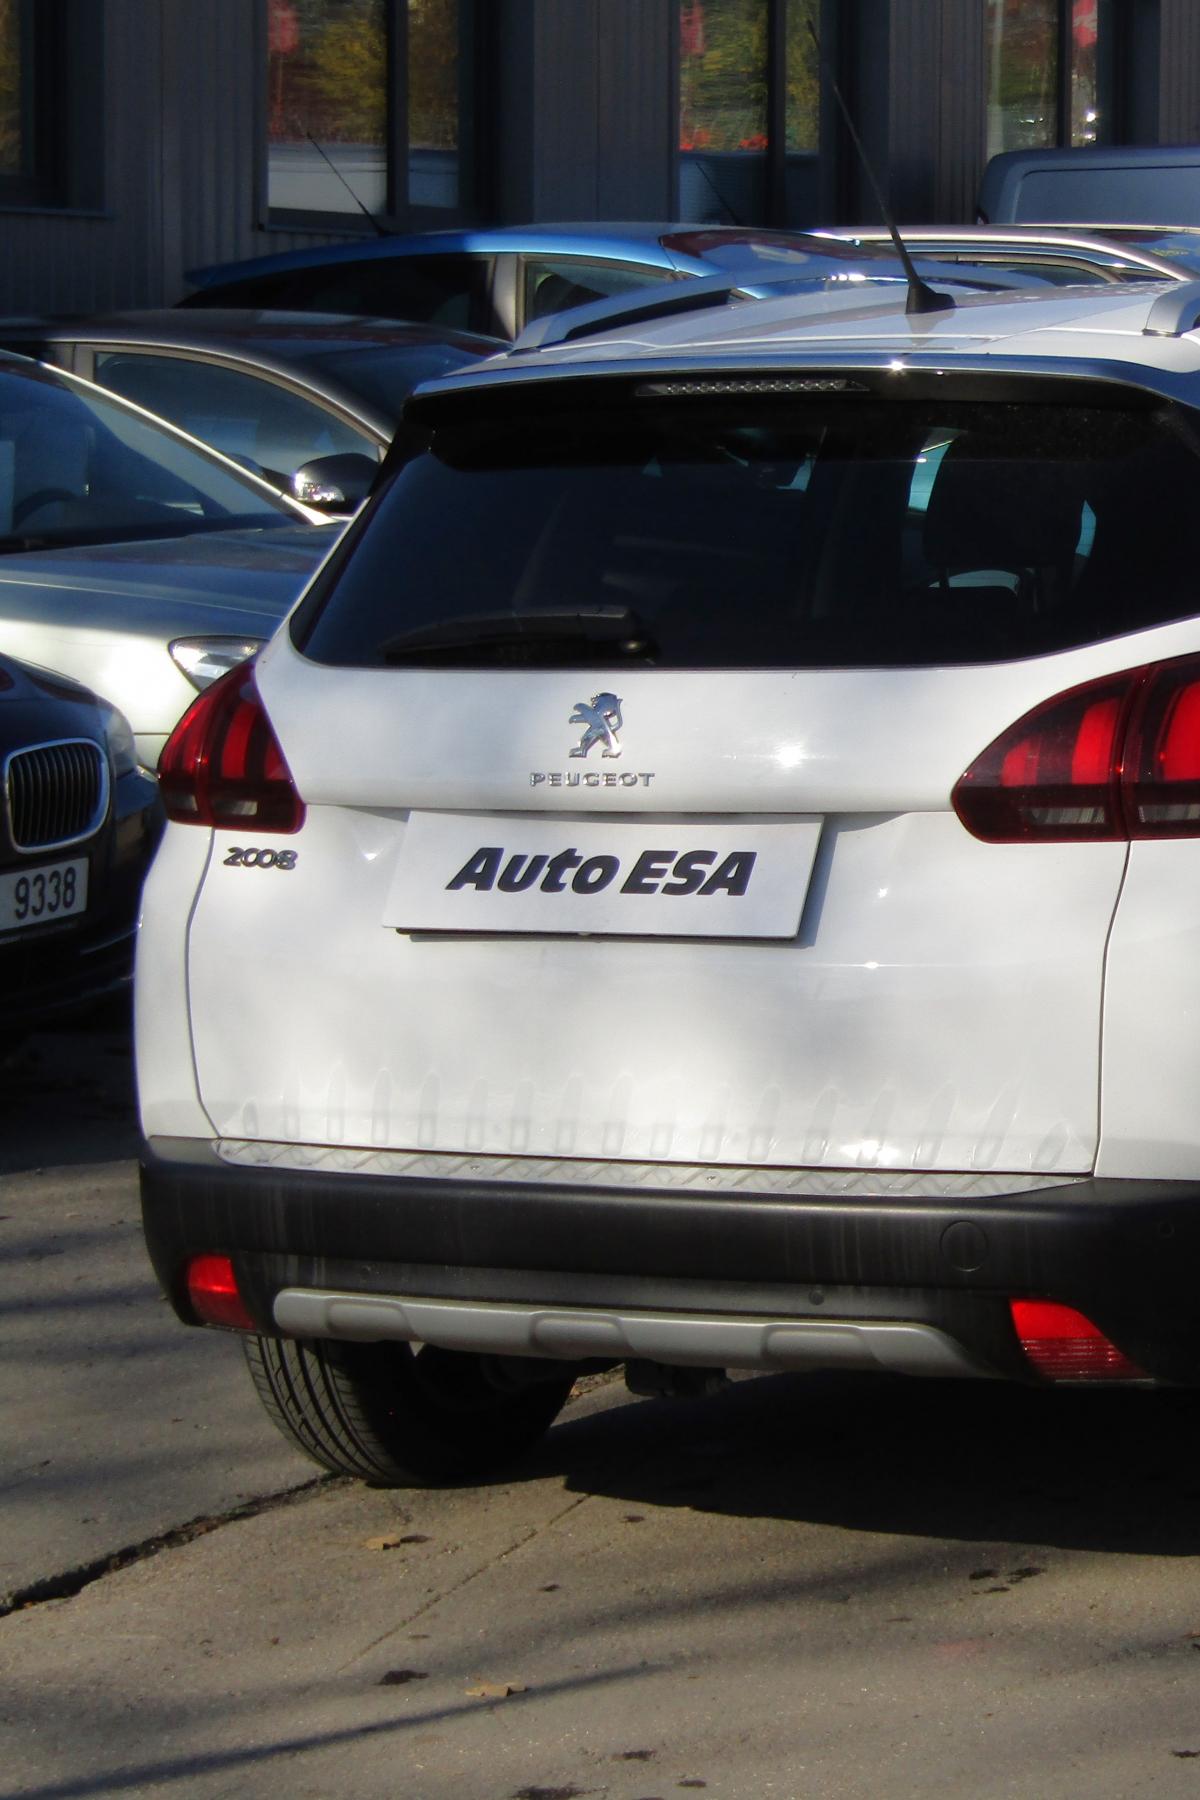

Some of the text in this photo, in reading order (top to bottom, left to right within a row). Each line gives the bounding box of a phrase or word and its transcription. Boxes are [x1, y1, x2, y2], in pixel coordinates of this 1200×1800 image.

[530, 771, 656, 787] PEUGEOT
[223, 847, 298, 870] 2008
[445, 846, 757, 896] Auto ESA
[14, 866, 76, 920] 9338
